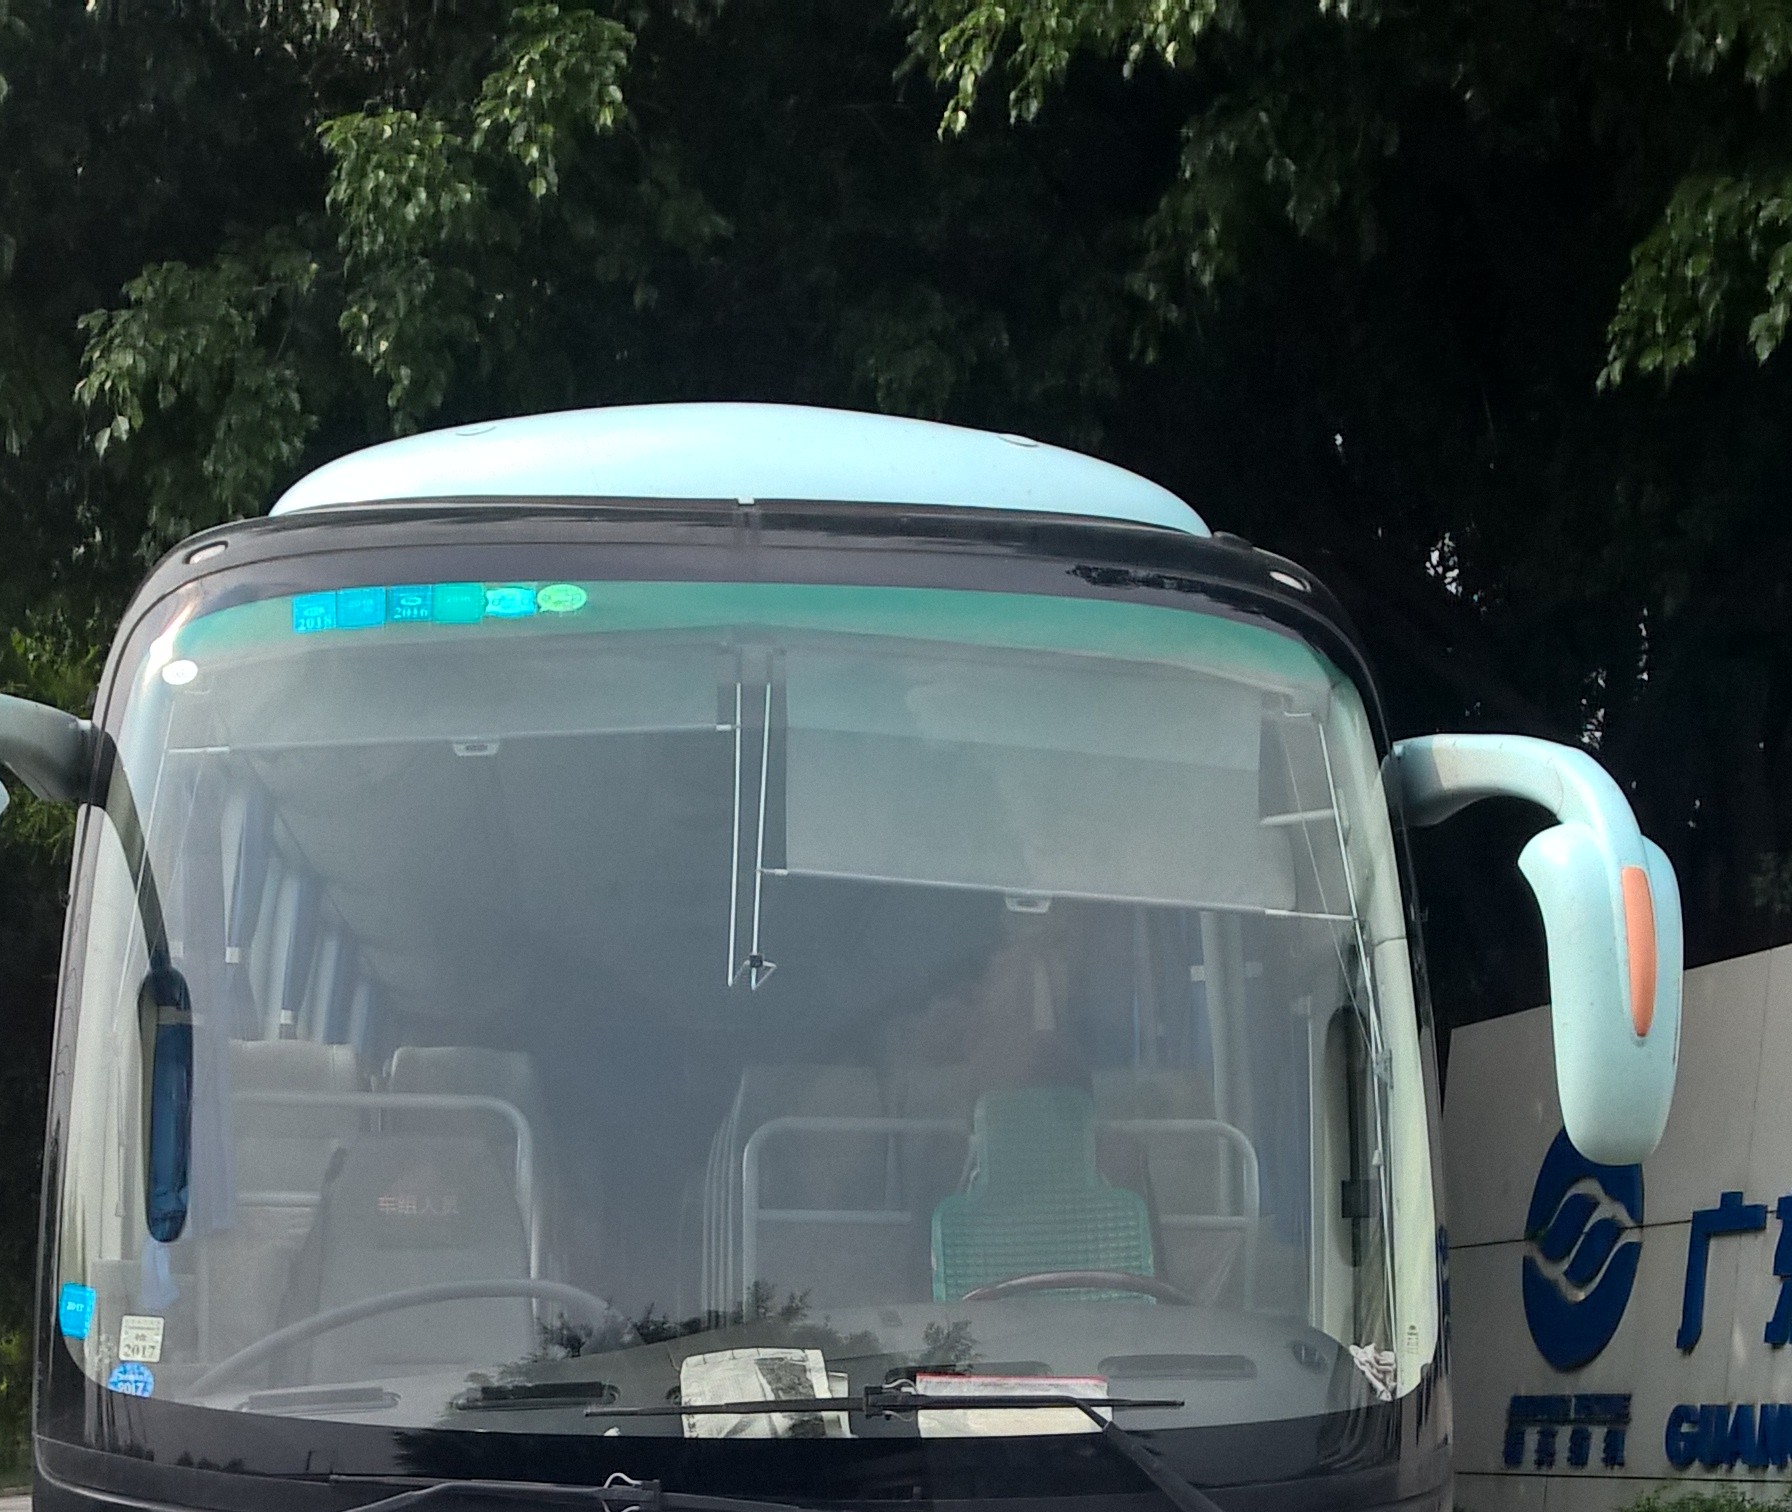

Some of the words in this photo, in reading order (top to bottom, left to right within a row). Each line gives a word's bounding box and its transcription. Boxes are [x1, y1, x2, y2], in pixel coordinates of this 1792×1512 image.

[377, 1194, 459, 1215] 车组人员
[122, 1343, 157, 1358] 2017
